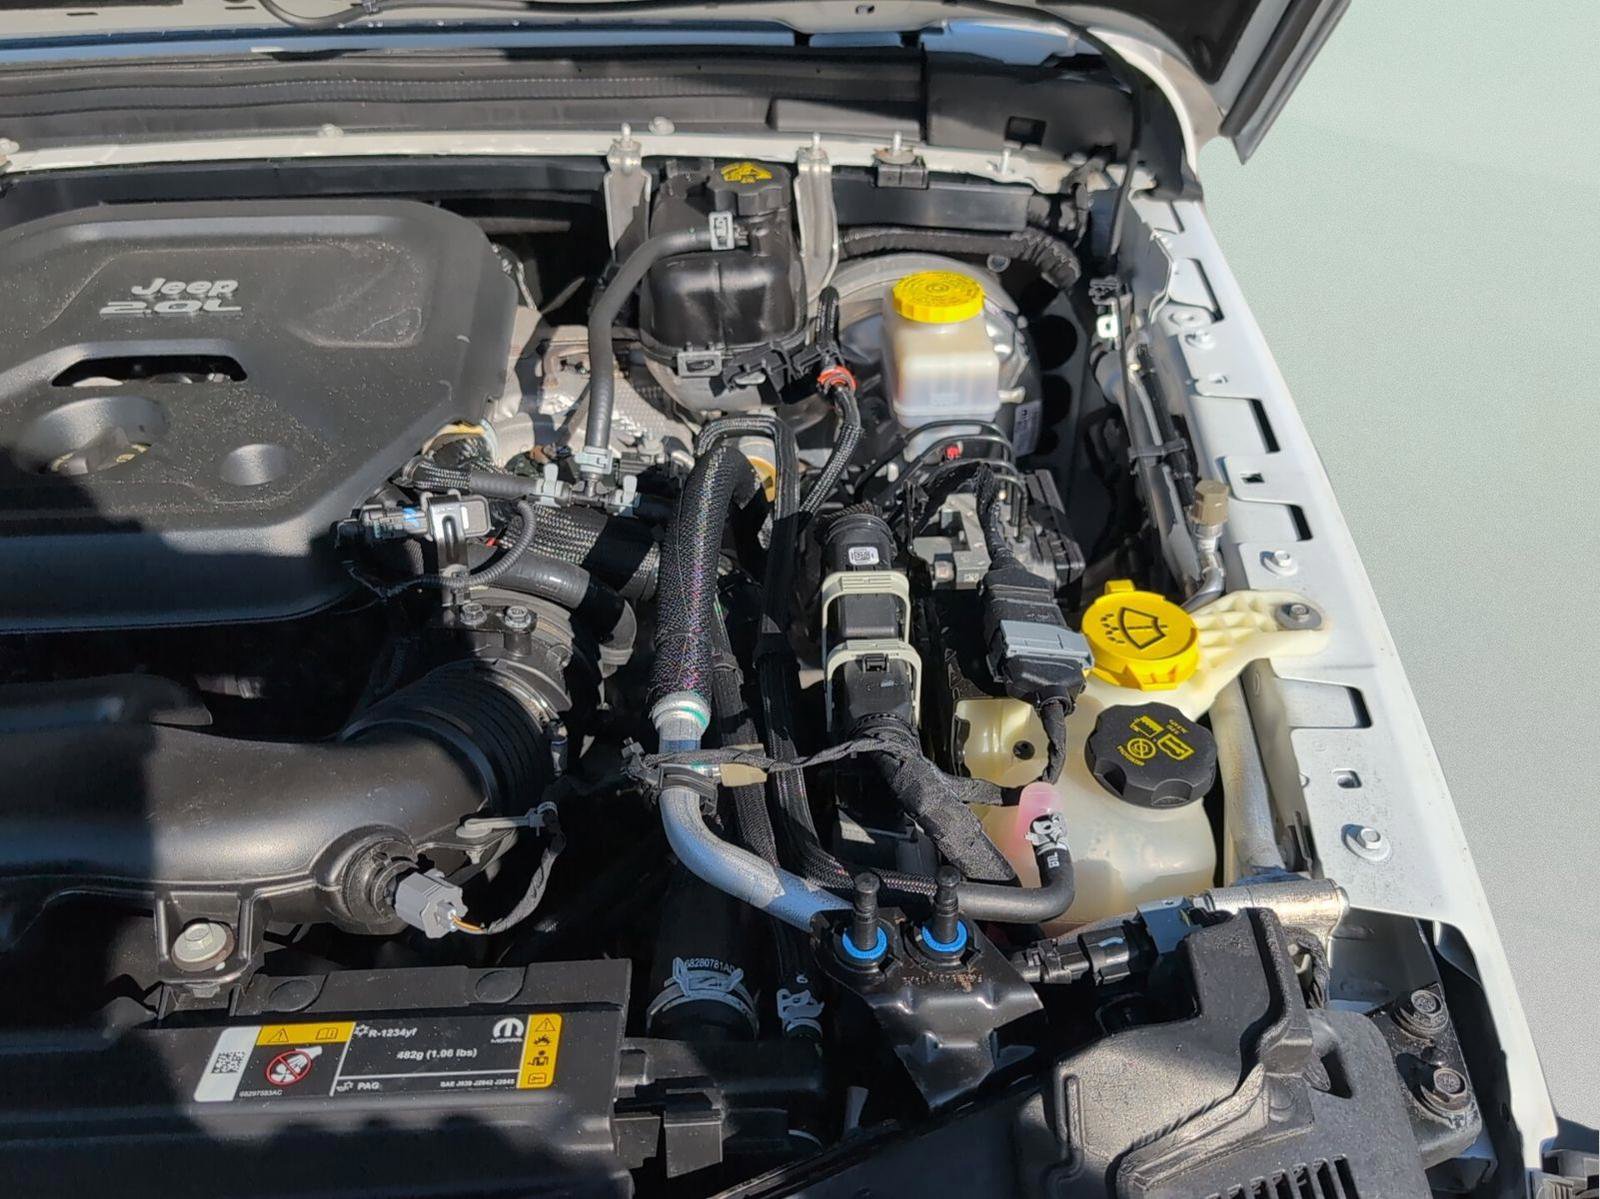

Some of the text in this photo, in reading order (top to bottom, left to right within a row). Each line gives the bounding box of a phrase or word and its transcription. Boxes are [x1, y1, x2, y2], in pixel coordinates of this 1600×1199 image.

[131, 277, 239, 297] Jeep
[368, 1027, 418, 1039] R-1234yf
[396, 1050, 424, 1061] 482g
[456, 1047, 477, 1058] lbs)
[357, 1081, 380, 1090] PAG
